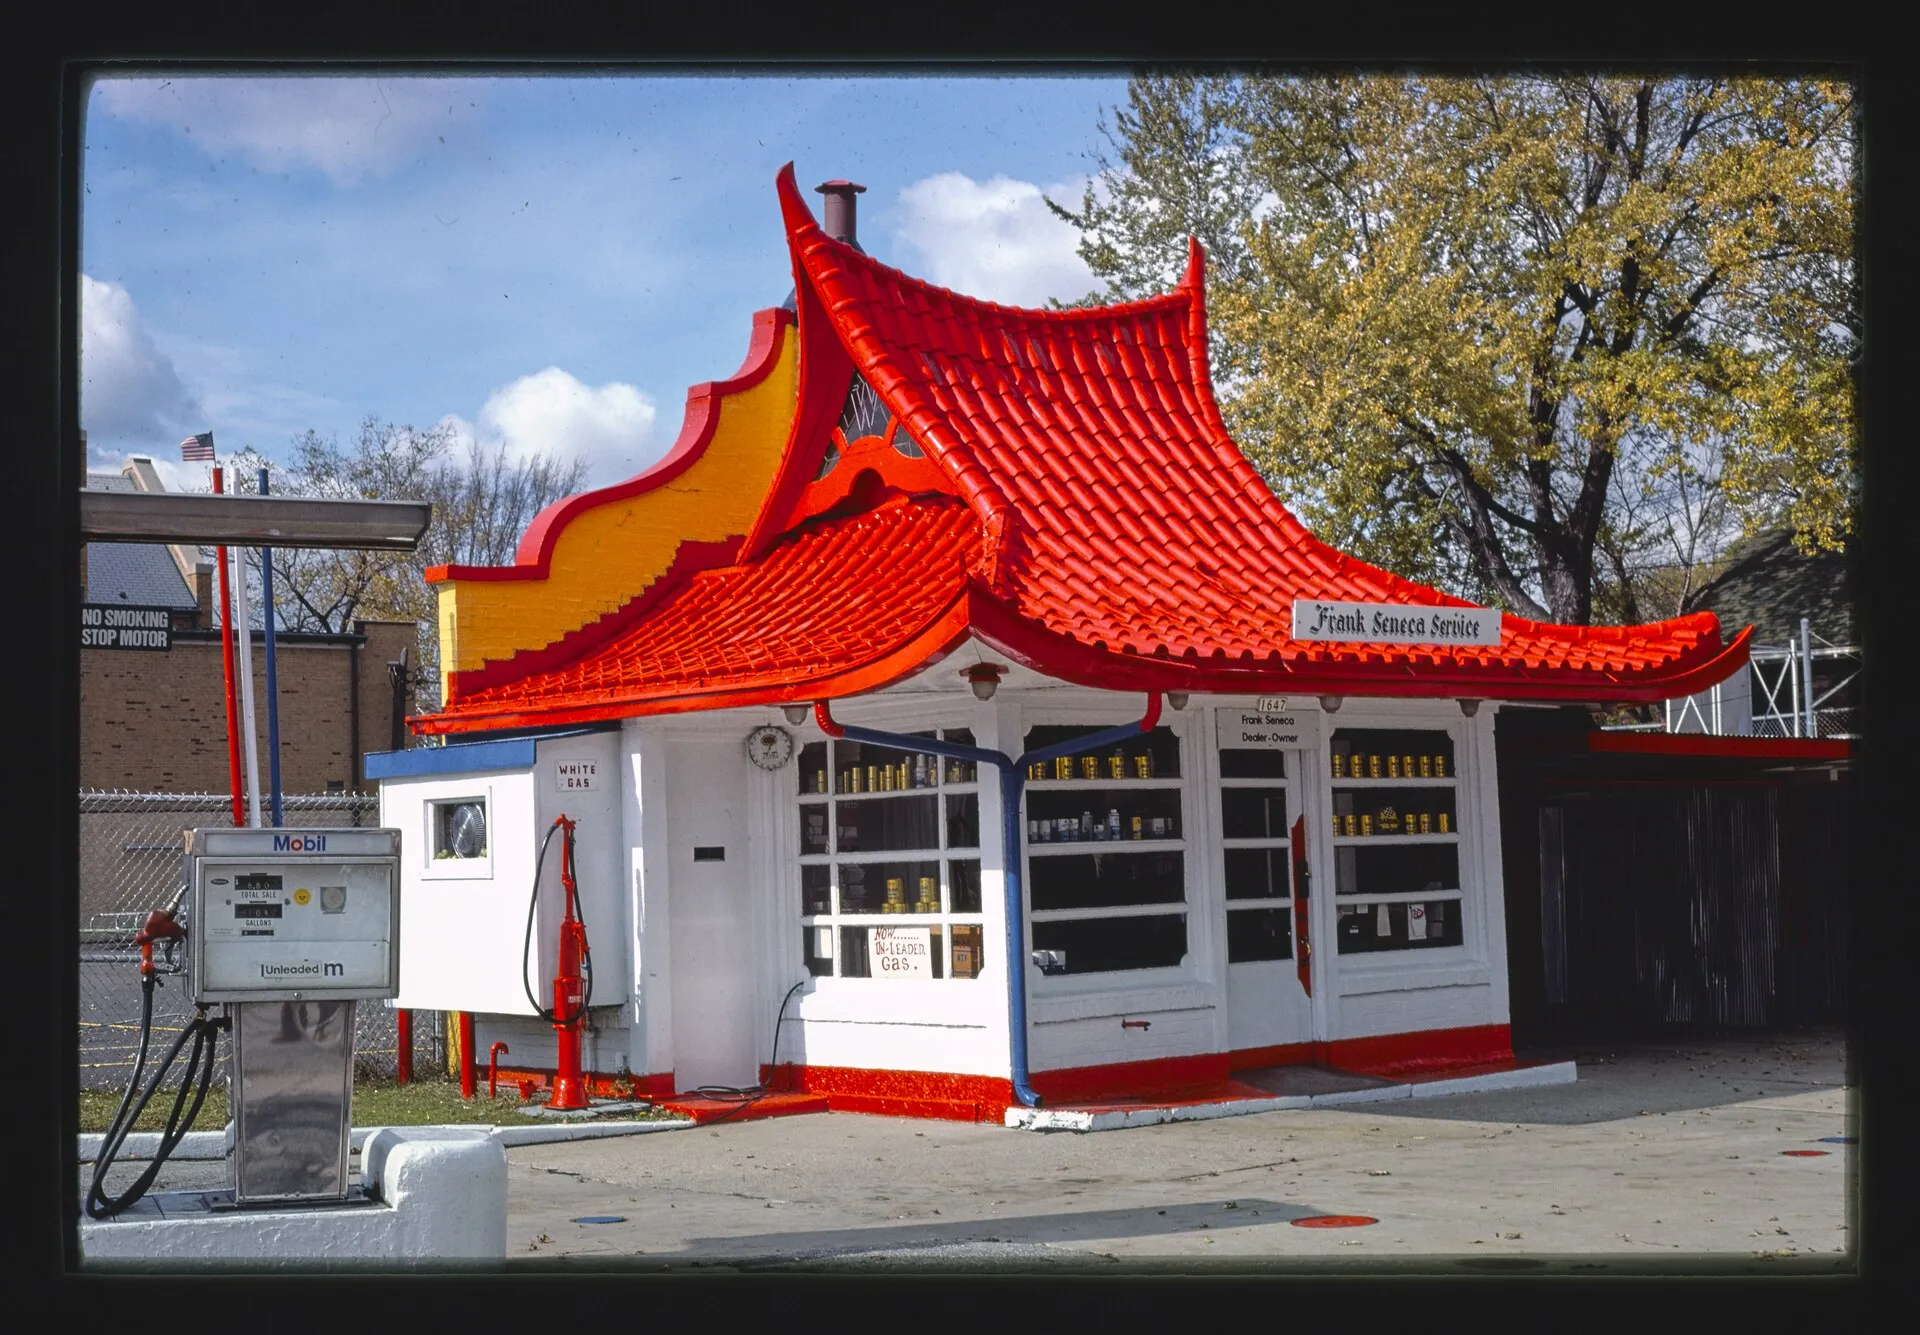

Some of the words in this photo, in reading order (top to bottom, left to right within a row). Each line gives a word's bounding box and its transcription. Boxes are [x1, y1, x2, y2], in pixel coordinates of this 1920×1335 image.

[82, 609, 101, 625] NO
[104, 609, 168, 628] SMOKING
[1310, 604, 1366, 635] Frank
[1372, 611, 1426, 637] Seneca
[1430, 612, 1480, 639] Service
[82, 628, 117, 645] STOP
[120, 629, 167, 647] MOTOR
[1261, 699, 1286, 710] 1647
[1241, 714, 1263, 725] Frank
[1265, 715, 1294, 725] Seneca
[567, 778, 589, 788] GAS
[273, 835, 326, 851] Mobil
[241, 891, 259, 899] TOTAL
[262, 891, 277, 899] SALE
[245, 919, 272, 927] GALLONS
[265, 964, 319, 974] Unleaded
